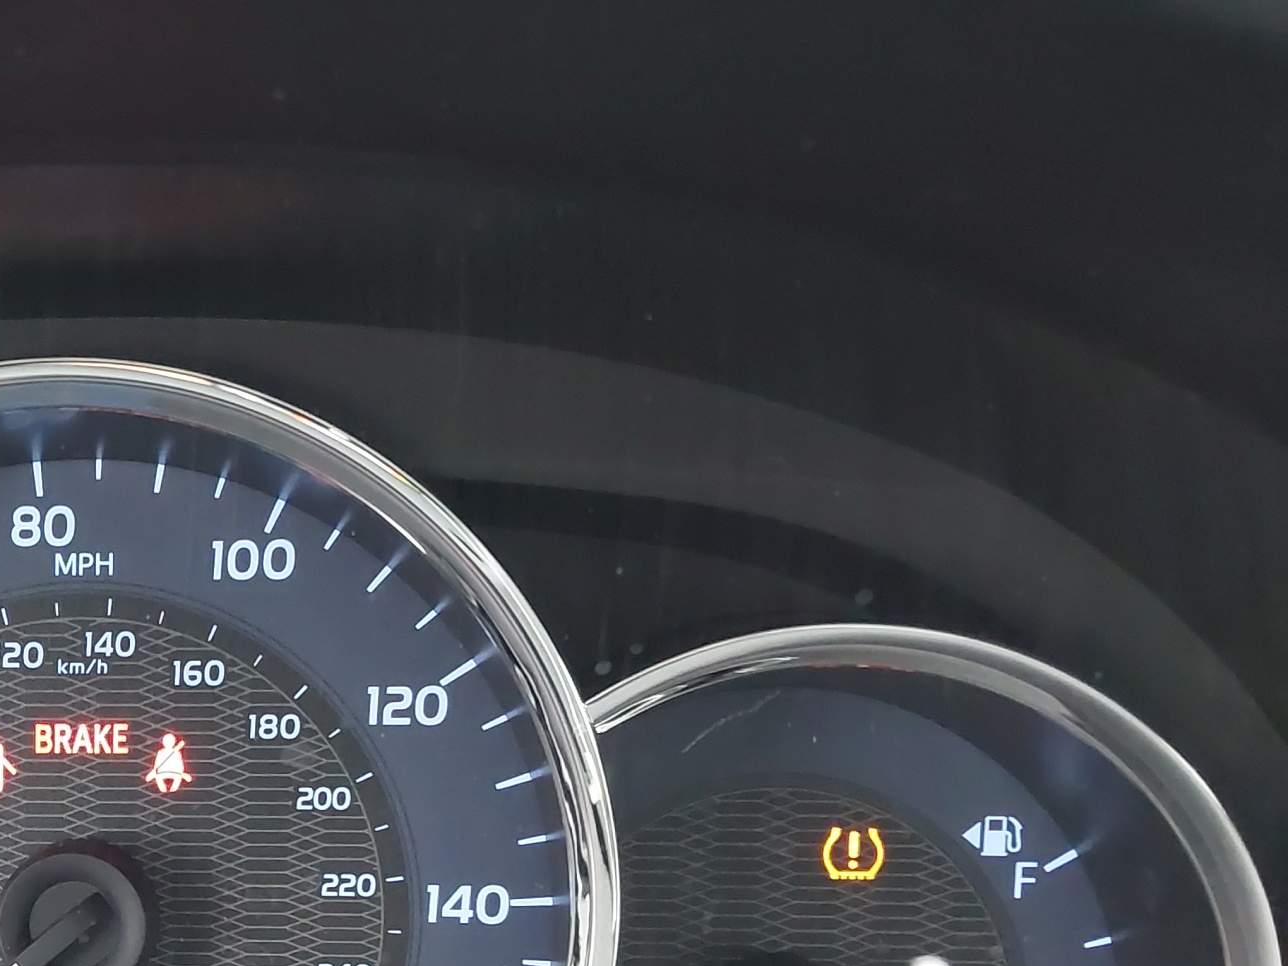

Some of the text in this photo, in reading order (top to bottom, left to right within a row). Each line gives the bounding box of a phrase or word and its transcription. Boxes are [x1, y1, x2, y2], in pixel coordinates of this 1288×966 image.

[11, 505, 76, 547] 80
[54, 552, 114, 576] MPH
[212, 538, 296, 581] 100
[85, 631, 136, 657] 140
[57, 658, 108, 675] km/h
[173, 660, 225, 687] 160
[367, 685, 448, 726] 120
[34, 723, 129, 754] BRAKE
[248, 713, 301, 740] 180
[296, 787, 351, 811] 200
[321, 873, 376, 897] 220
[1014, 862, 1038, 898] F
[426, 884, 510, 925] 140
